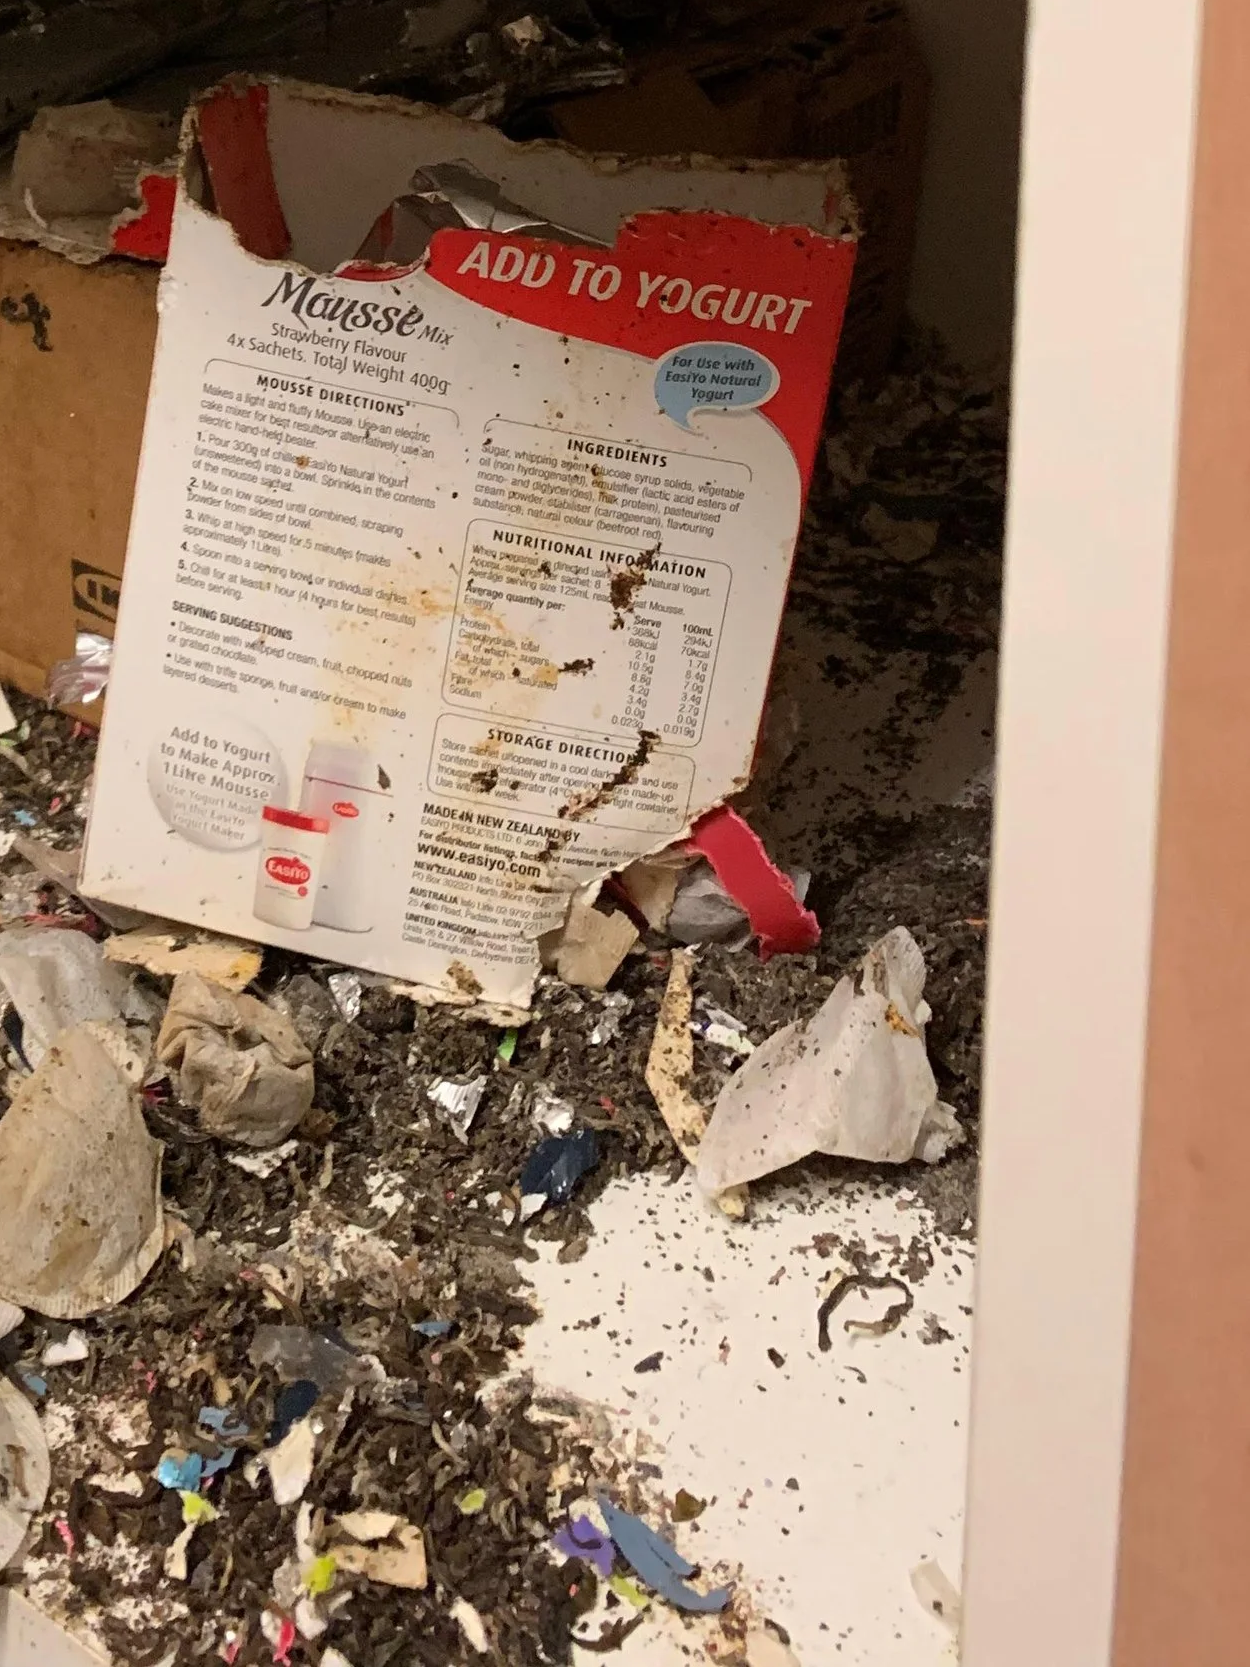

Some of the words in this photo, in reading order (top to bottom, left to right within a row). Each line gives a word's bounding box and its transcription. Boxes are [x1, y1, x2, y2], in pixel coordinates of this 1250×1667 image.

[456, 241, 555, 288] ADD
[567, 259, 622, 302] TO
[634, 271, 812, 335] YOGURT
[271, 322, 349, 354] Strawberry
[353, 340, 408, 364] Flavour
[417, 324, 455, 346] Mix
[226, 333, 245, 348] 4x
[248, 337, 307, 363] Sachets.
[313, 350, 348, 374] Total
[352, 359, 405, 384] Weight
[409, 372, 450, 396] 400g
[665, 370, 707, 384] EasiYo
[710, 373, 762, 387] Natural
[672, 355, 693, 367] For
[696, 357, 721, 370] Use
[724, 359, 755, 371] with
[256, 374, 314, 397] MOUSSE
[318, 387, 405, 417] DIRECTIONS
[691, 387, 735, 402] Yogurt
[199, 398, 223, 412] cake
[224, 403, 251, 418] mixer
[253, 410, 267, 422] for
[268, 413, 290, 427] best
[339, 429, 399, 453] alternatively
[400, 444, 419, 456] use
[420, 449, 434, 459] an
[201, 382, 234, 399] Makes
[235, 392, 242, 401] a
[244, 392, 266, 408] light
[266, 397, 286, 411] and
[393, 425, 431, 443] electric
[197, 412, 232, 429] electric
[284, 432, 318, 449] beater.
[195, 430, 206, 443] 1.
[207, 433, 231, 448] Pour
[231, 438, 259, 457] 300g
[259, 444, 270, 457] of
[339, 463, 375, 481] Natural
[376, 471, 408, 490] Yogurt
[567, 438, 668, 468] INGREDIENTS
[191, 458, 201, 469] of
[203, 461, 219, 474] the
[220, 467, 258, 483] mousse
[263, 461, 283, 475] into
[283, 468, 290, 476] a
[362, 483, 372, 494] in
[374, 486, 391, 499] the
[392, 490, 436, 509] contents
[478, 456, 490, 467] oil
[492, 459, 515, 474] (non
[590, 476, 639, 494] emulsifier
[641, 485, 671, 502] (lactic
[672, 491, 695, 504] acid
[696, 495, 727, 510] esters
[728, 501, 740, 513] of
[513, 449, 558, 468] whipping
[633, 473, 661, 487] syrup
[697, 482, 745, 502] vegetable
[188, 476, 199, 488] 2.
[201, 480, 218, 493] Mix
[219, 486, 233, 496] on
[235, 487, 252, 501] low
[253, 492, 284, 511] speed
[284, 499, 306, 514] until
[360, 517, 404, 539] scraping
[223, 499, 247, 513] from
[247, 505, 274, 520] sides
[275, 511, 286, 523] of
[474, 484, 505, 497] cream
[546, 495, 591, 513] stabiliser
[666, 517, 715, 538] flavouring
[510, 476, 530, 488] and
[663, 504, 721, 525] pasteurised
[526, 506, 561, 521] natural
[563, 512, 593, 527] colour
[181, 524, 247, 550] approximately
[184, 508, 194, 520] 3.
[196, 511, 221, 529] Whip
[222, 517, 233, 529] at
[233, 520, 256, 537] high
[257, 526, 287, 545] speed
[288, 534, 302, 547] for
[492, 529, 594, 559] NUTRITIONAL
[179, 539, 190, 552] 4.
[191, 543, 222, 563] Spoon
[224, 552, 243, 566] into
[243, 559, 250, 568] a
[252, 559, 288, 579] serving
[314, 575, 324, 585] or
[327, 576, 373, 597] individual
[647, 577, 680, 591] Natural
[176, 558, 188, 570] 5.
[189, 561, 210, 576] Chill
[212, 567, 225, 580] for
[227, 571, 238, 584] at
[239, 574, 263, 590] least
[273, 582, 296, 597] hour
[310, 591, 339, 608] hours
[340, 598, 355, 611] for
[356, 601, 378, 617] best
[379, 607, 416, 628] results)
[505, 591, 544, 608] quantity
[545, 600, 566, 612] per:
[539, 580, 557, 592] size
[171, 599, 218, 621] SERVING
[218, 612, 293, 641] SUGGESTIONS
[633, 615, 662, 628] Serve
[682, 623, 714, 637] 100mL
[345, 662, 389, 684] chopped
[390, 673, 413, 688] nuts
[332, 695, 365, 710] cream
[366, 701, 377, 712] to
[378, 703, 407, 719] make
[170, 726, 200, 744] Add
[203, 735, 218, 750] to
[223, 739, 271, 763] Yogurt
[486, 727, 553, 751] STORAGE
[161, 742, 176, 756] to
[179, 748, 218, 769] Make
[222, 760, 281, 786] Approx.
[438, 751, 479, 768] contents
[538, 770, 561, 783] after
[549, 759, 559, 769] in
[560, 763, 567, 771] a
[568, 762, 589, 775] cool
[640, 775, 660, 787] and
[660, 780, 678, 790] use
[210, 775, 269, 801] Mousse
[418, 830, 433, 840] For
[422, 802, 459, 820] MADE
[476, 812, 504, 829] NEW
[506, 818, 560, 839] ZEALAND
[564, 829, 580, 843] BY
[414, 842, 542, 879] www.easiyo.com
[408, 886, 458, 904] AUSTRALIA
[404, 912, 435, 927] UNITED
[436, 919, 476, 935] KINGDOM
